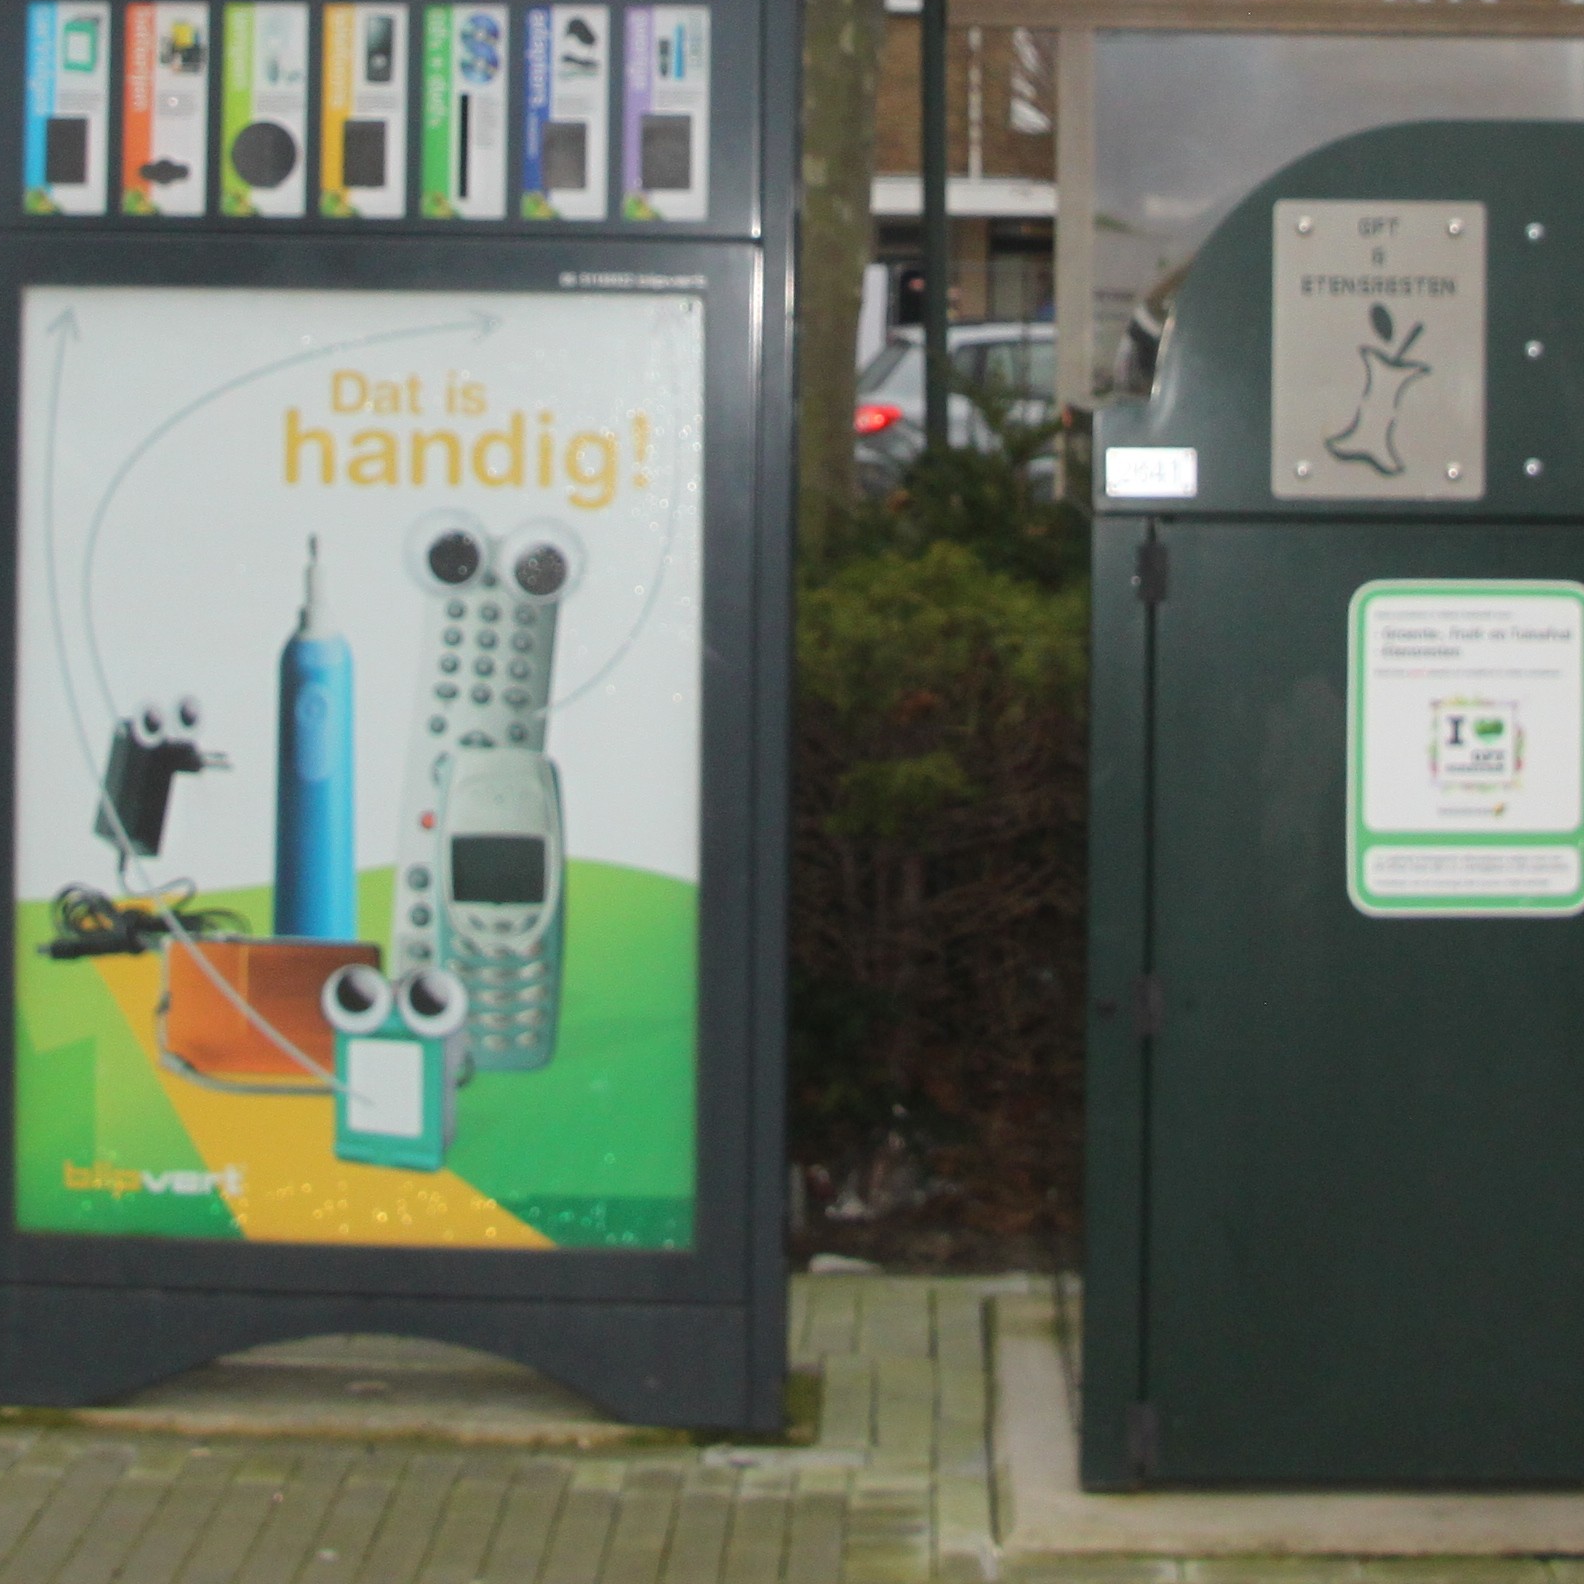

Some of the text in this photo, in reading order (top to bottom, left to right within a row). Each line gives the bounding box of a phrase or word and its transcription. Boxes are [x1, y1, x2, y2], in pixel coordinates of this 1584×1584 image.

[1301, 276, 1456, 296] ETENSRESTEN
[331, 369, 488, 415] Dat is
[283, 407, 652, 510] handig!
[63, 1160, 244, 1199] blipvert
